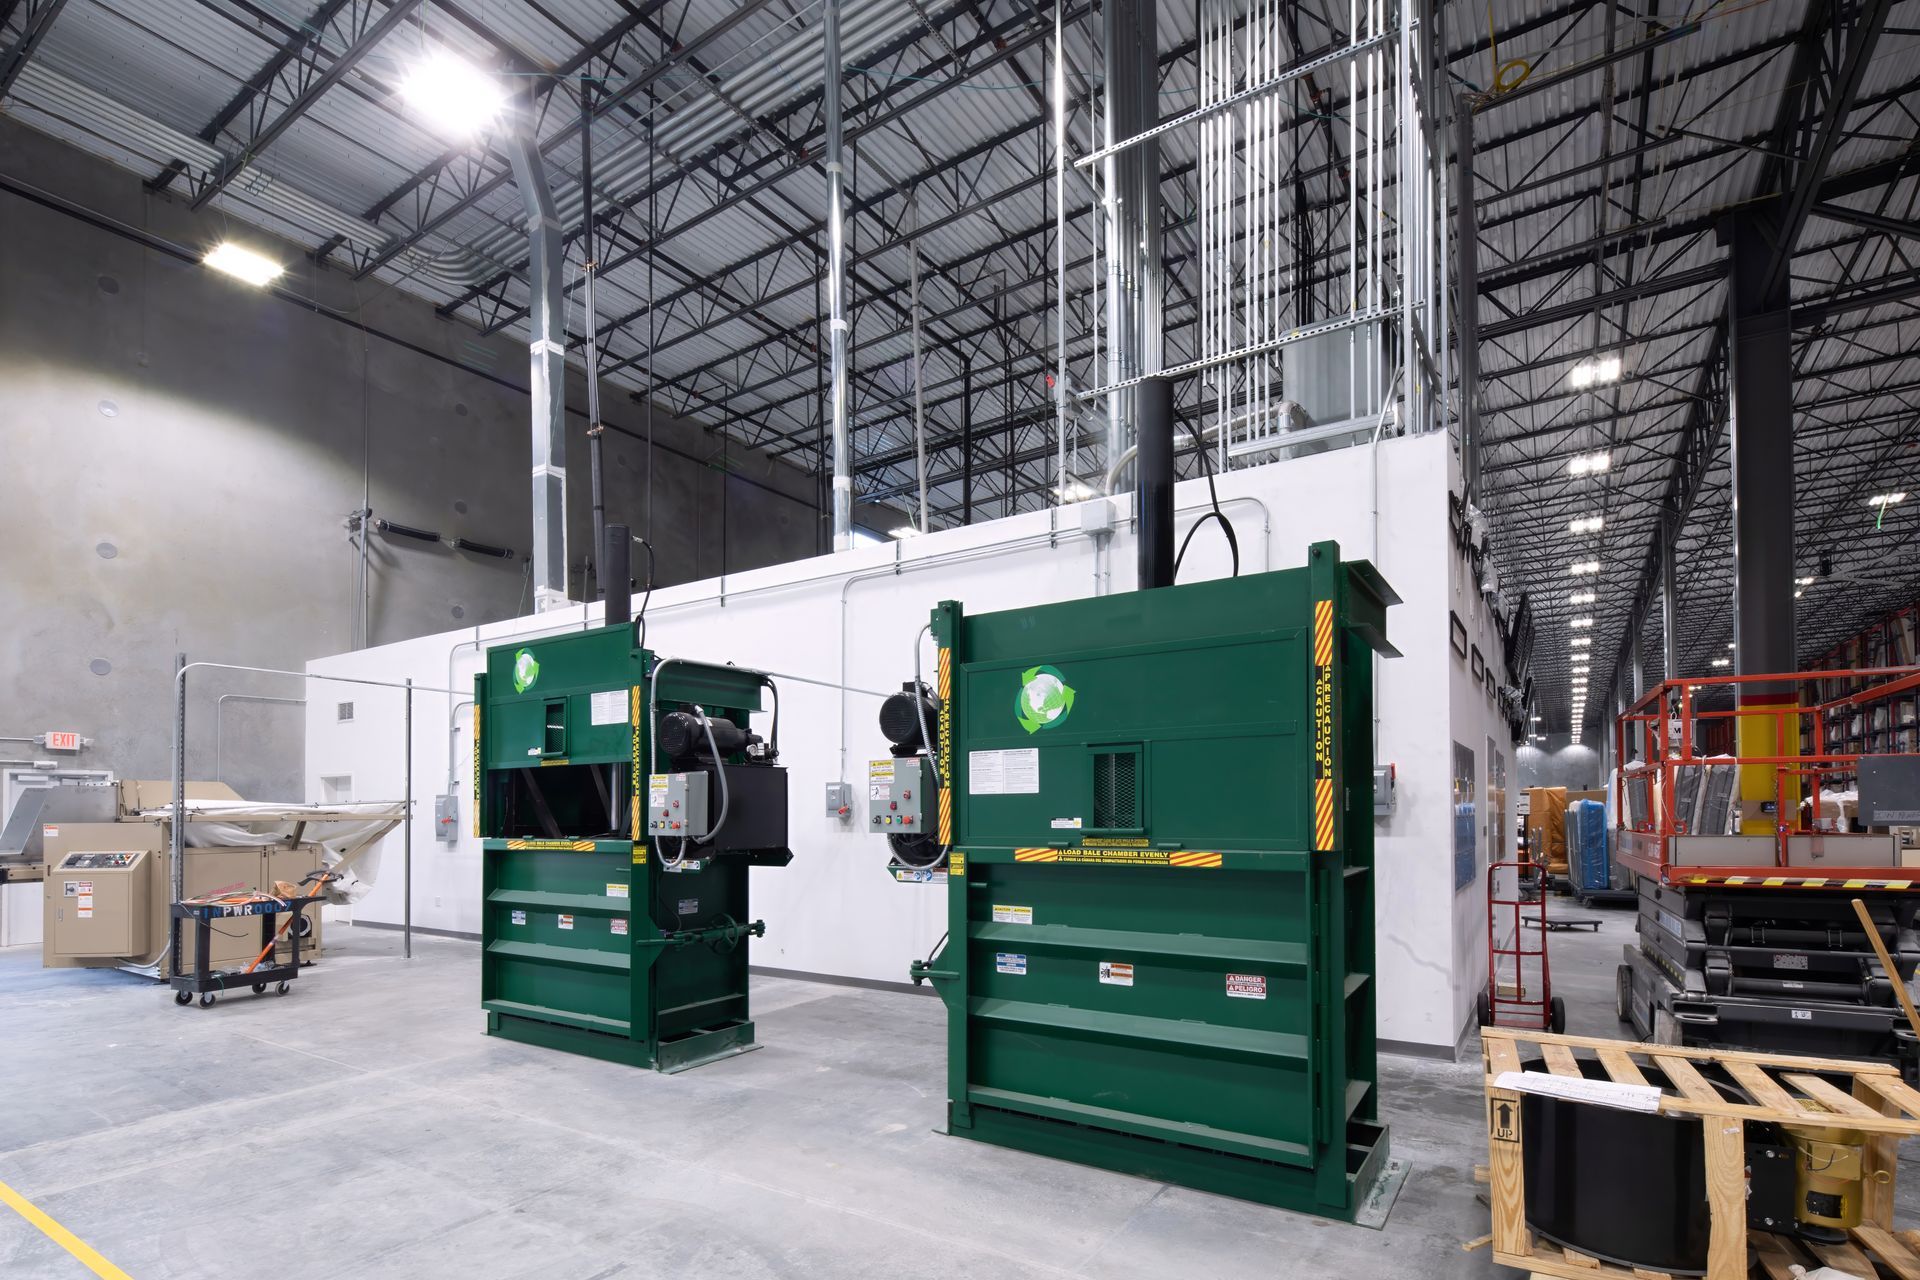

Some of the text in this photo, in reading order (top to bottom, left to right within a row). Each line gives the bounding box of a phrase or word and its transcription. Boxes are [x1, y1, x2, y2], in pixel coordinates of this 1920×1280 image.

[53, 733, 76, 747] EXIT
[1235, 975, 1262, 983] DANGER
[1234, 985, 1263, 993] PELIGRO
[1497, 1128, 1513, 1138] UP
